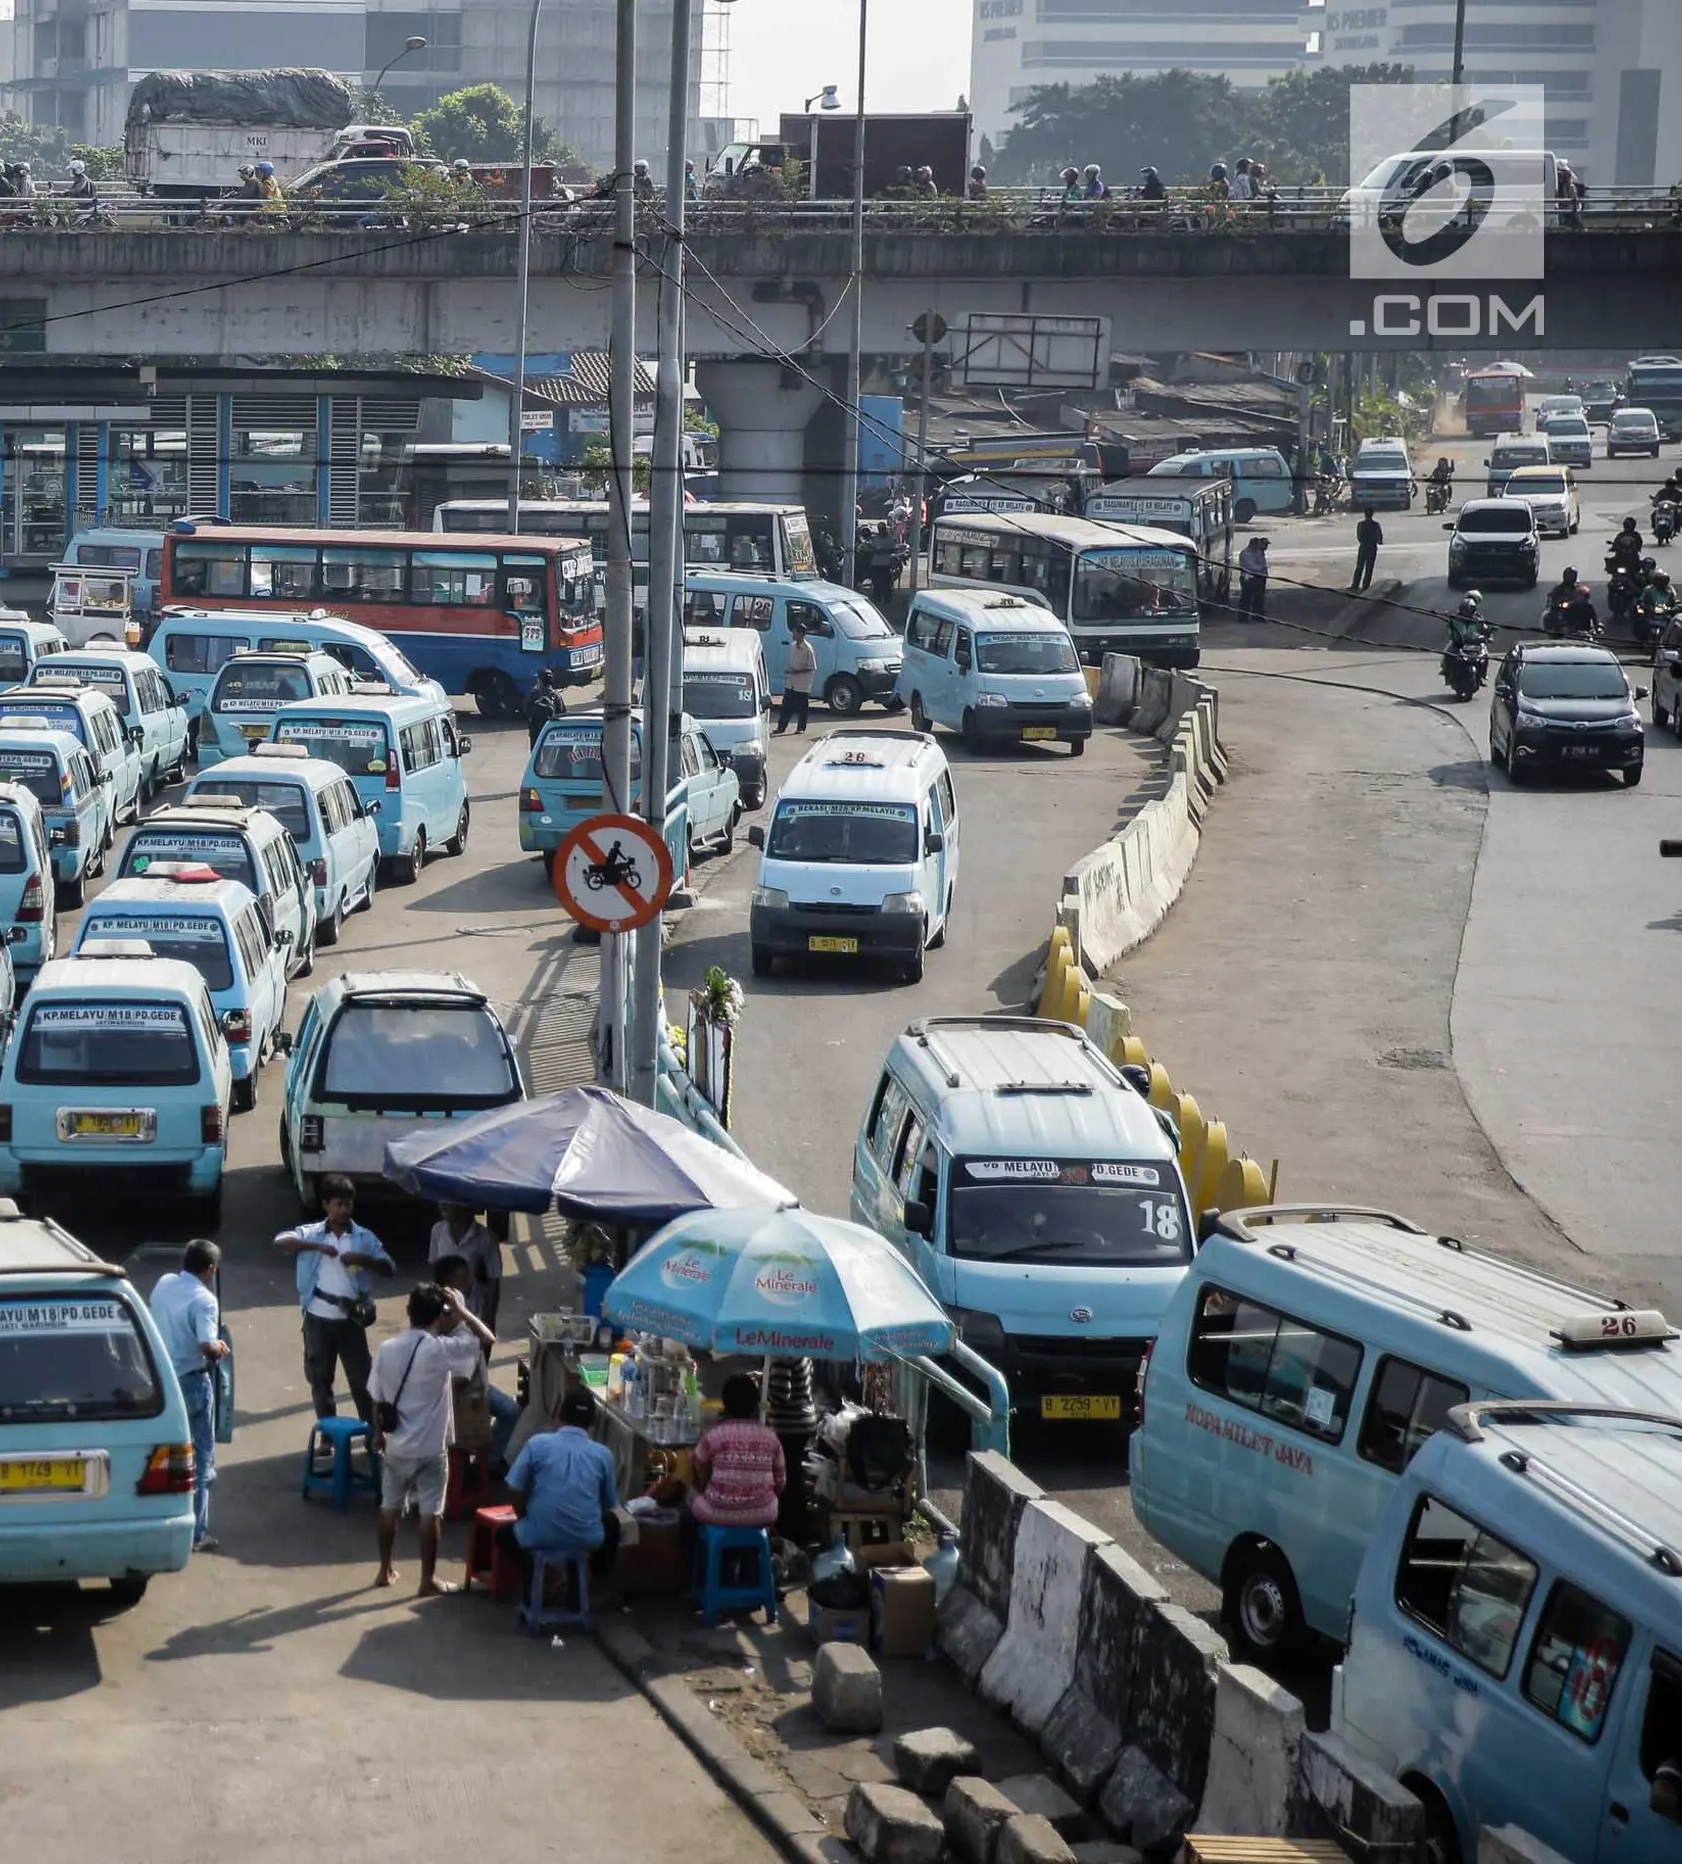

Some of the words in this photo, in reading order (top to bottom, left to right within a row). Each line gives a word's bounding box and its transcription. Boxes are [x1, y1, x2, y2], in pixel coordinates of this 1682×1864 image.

[1342, 9, 1387, 30] PREMIER
[246, 136, 267, 146] MKI
[798, 804, 827, 813] BEKASI
[116, 921, 149, 929] MELAYU
[107, 1010, 131, 1020] M18
[134, 1011, 177, 1021] PD.GEDE
[1004, 1161, 1053, 1173] MELAYU
[1138, 1200, 1179, 1240] 18
[685, 1256, 701, 1269] Le
[666, 1260, 711, 1282] Minerale
[777, 1269, 794, 1281] Le
[755, 1277, 818, 1293] Minerale
[27, 1307, 58, 1321] M18
[61, 1305, 114, 1320] PD.GEDE
[1601, 1316, 1636, 1337] 26
